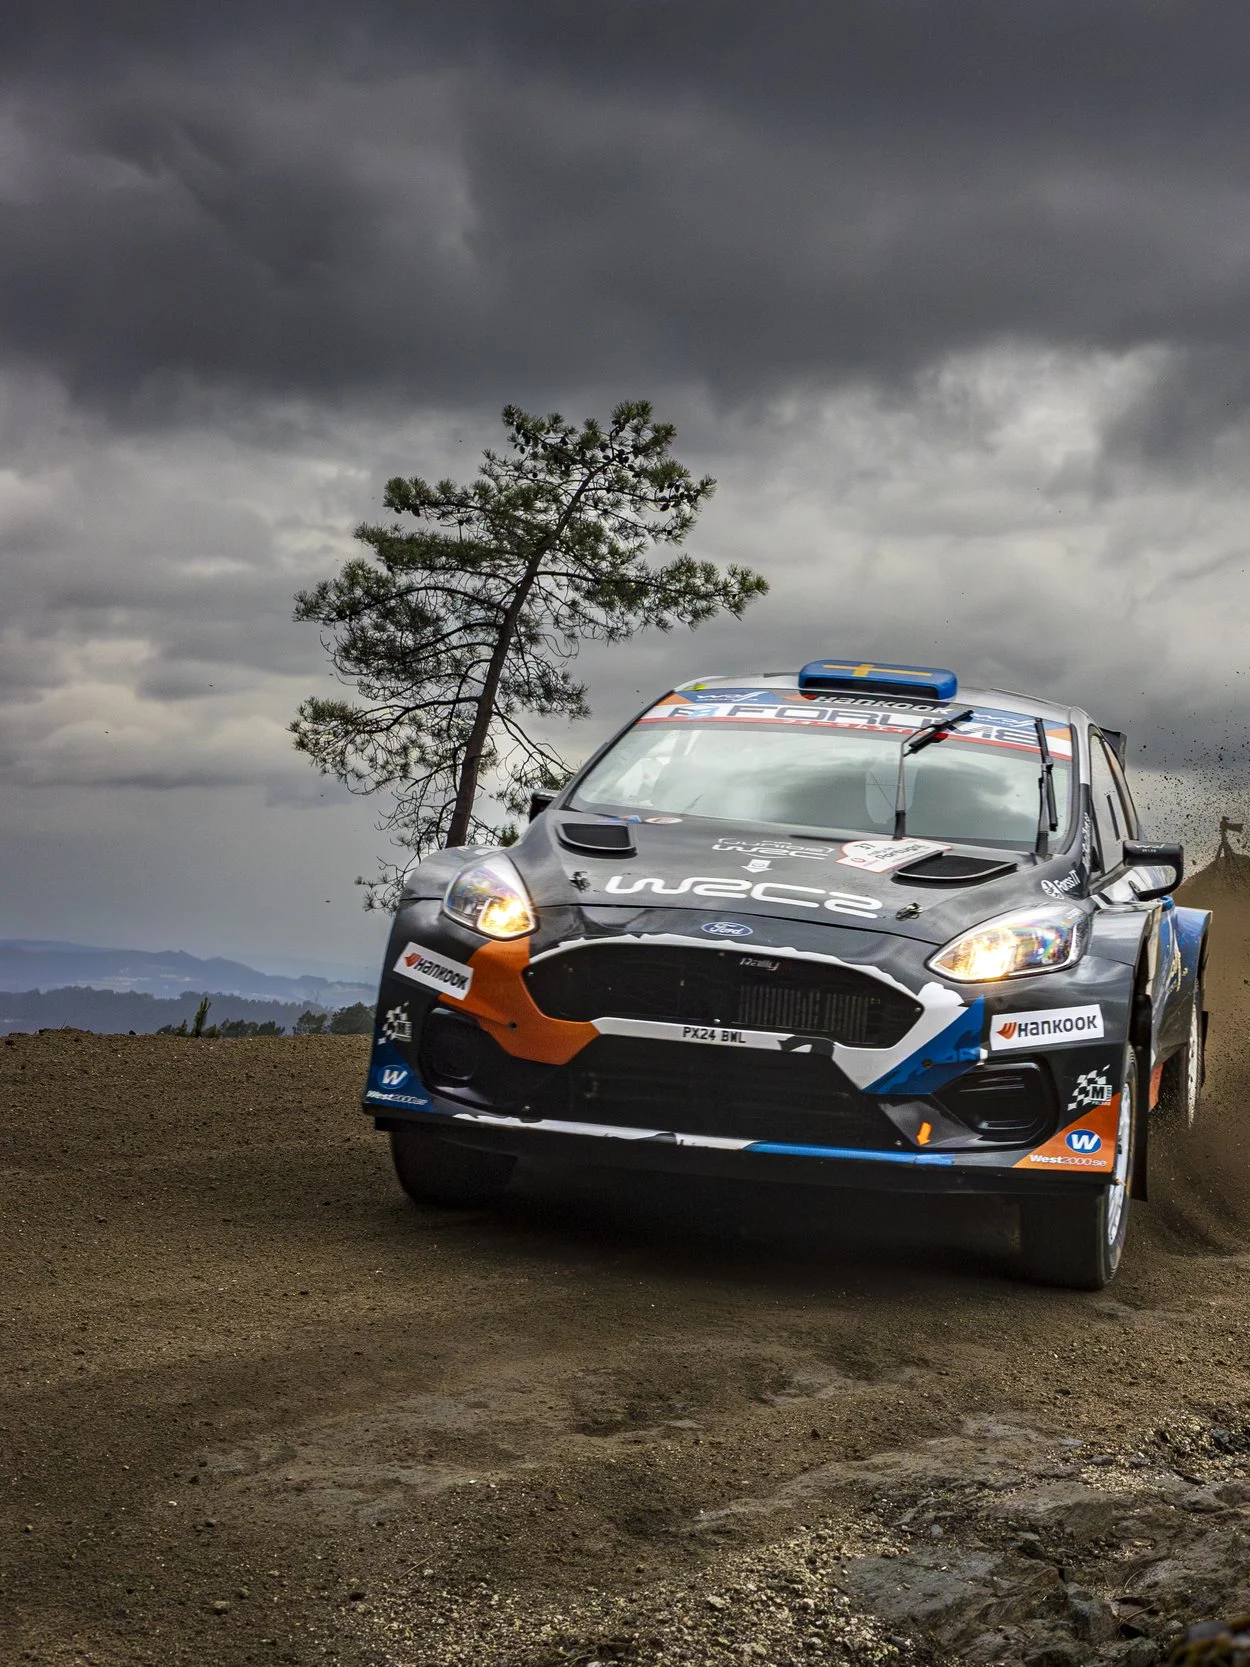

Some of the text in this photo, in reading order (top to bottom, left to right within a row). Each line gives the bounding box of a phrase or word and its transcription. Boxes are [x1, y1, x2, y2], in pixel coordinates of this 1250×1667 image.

[605, 875, 883, 919] WRC2
[710, 922, 743, 934] Ford
[682, 1027, 747, 1044] PX24 BWL
[382, 1069, 408, 1085] W
[1091, 1086, 1104, 1100] M
[1071, 1134, 1098, 1150] W
